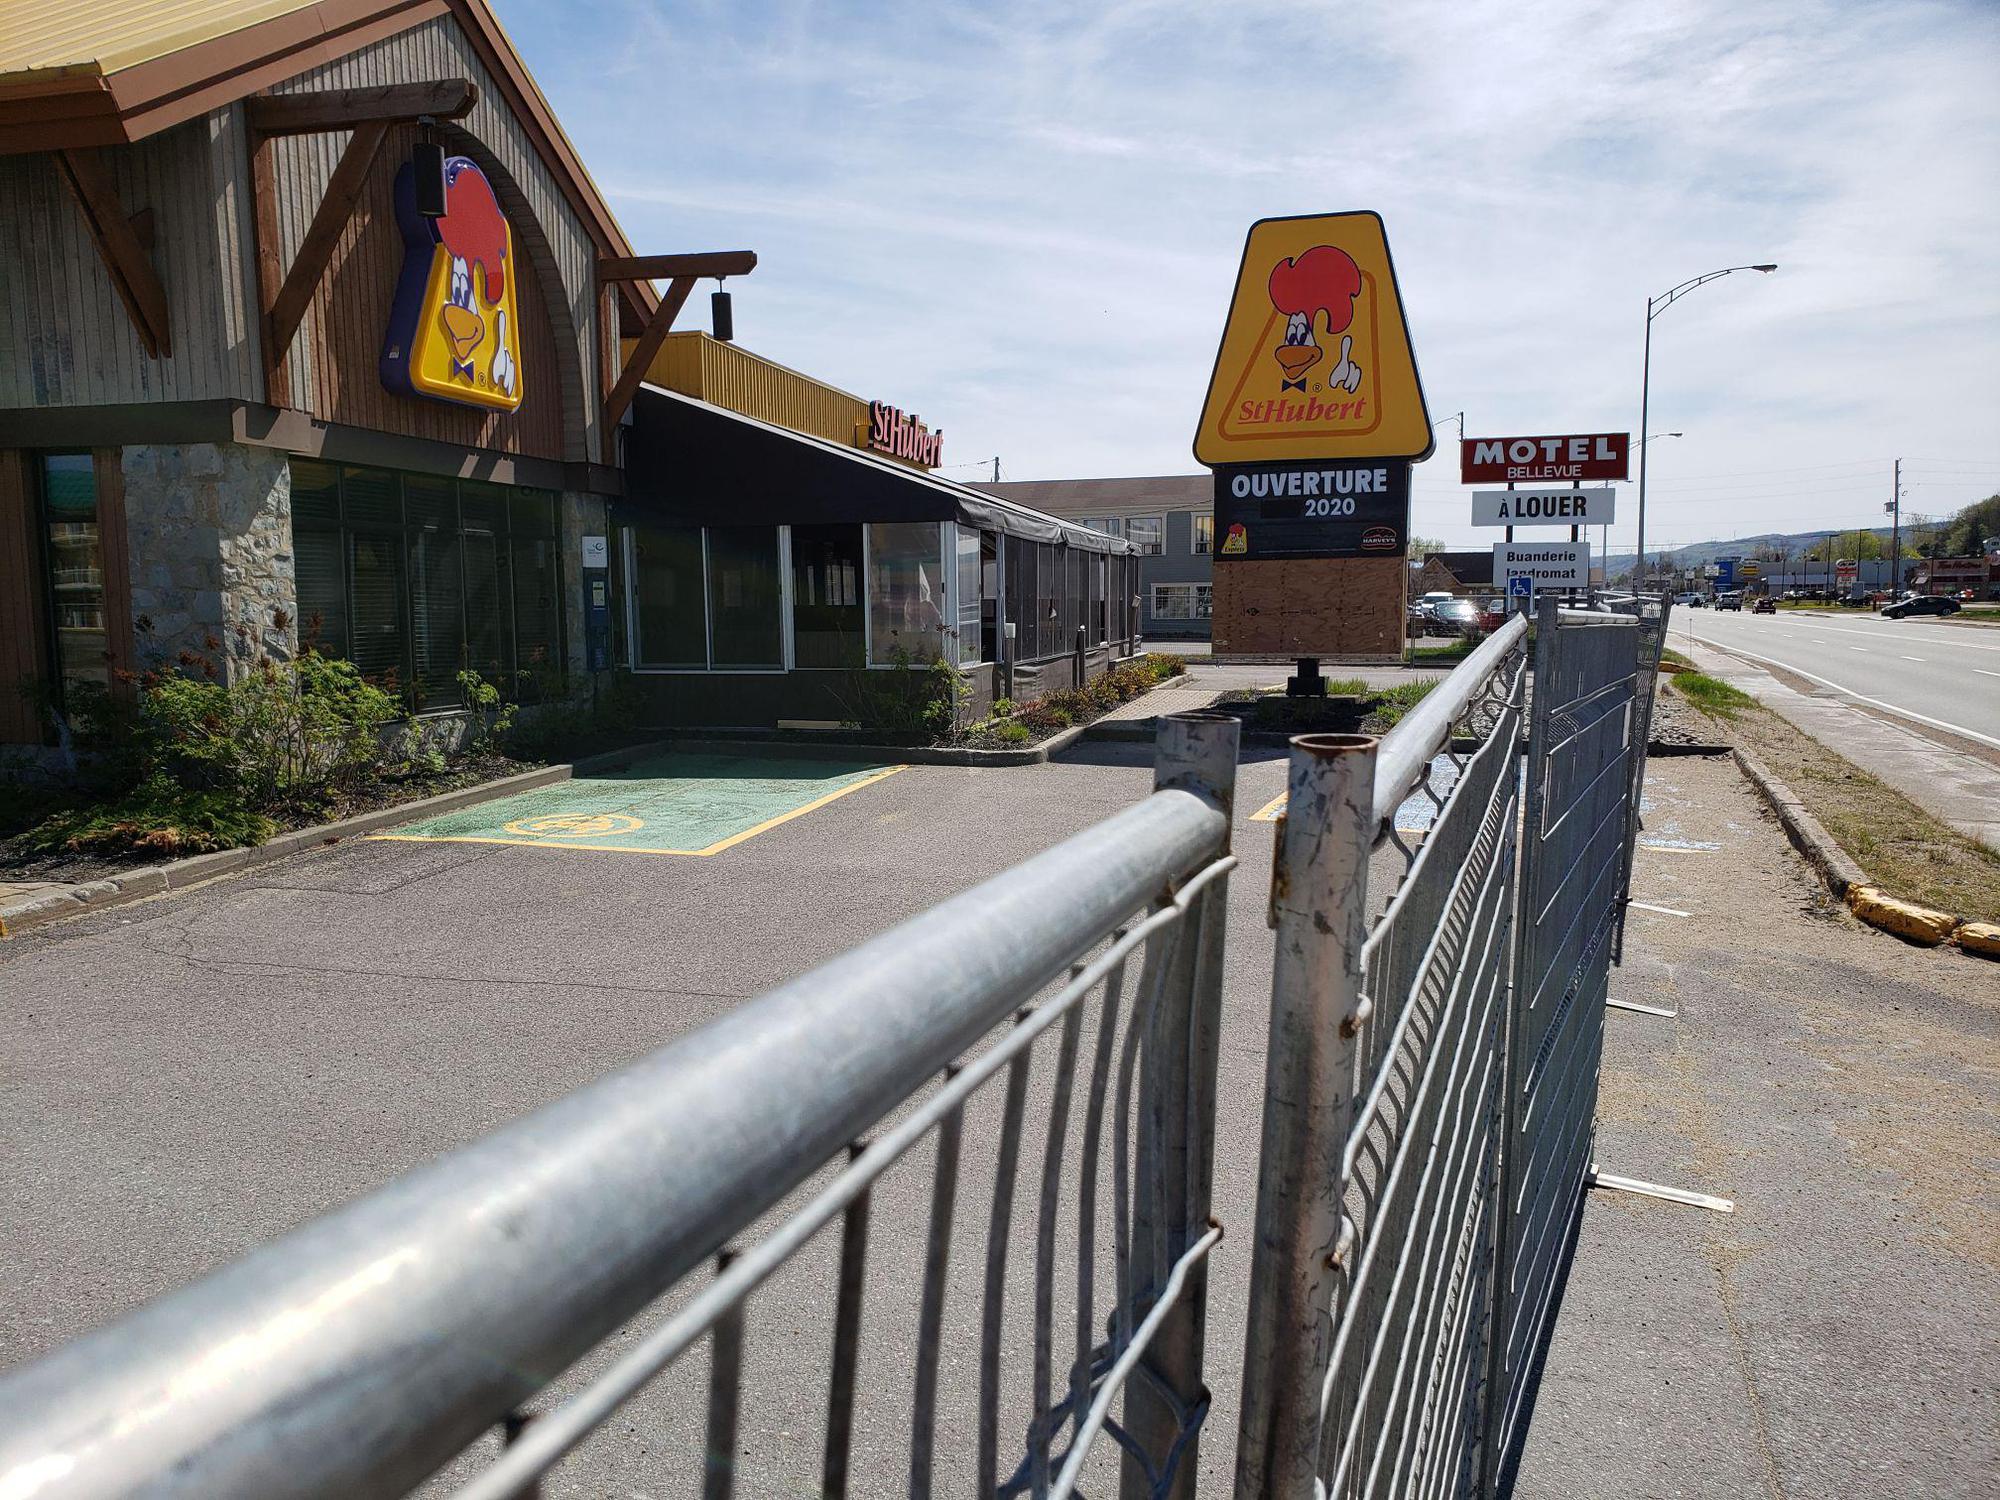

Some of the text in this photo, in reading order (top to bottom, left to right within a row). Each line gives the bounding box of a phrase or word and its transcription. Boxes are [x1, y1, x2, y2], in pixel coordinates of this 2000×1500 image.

[1473, 437, 1617, 465] MOTEL
[1507, 464, 1583, 479] BELLEVUE
[1231, 468, 1387, 498] OUVERTURE
[1304, 497, 1356, 517] 2020
[1498, 495, 1587, 518] À LOUER
[1507, 551, 1576, 562] Buanderie
